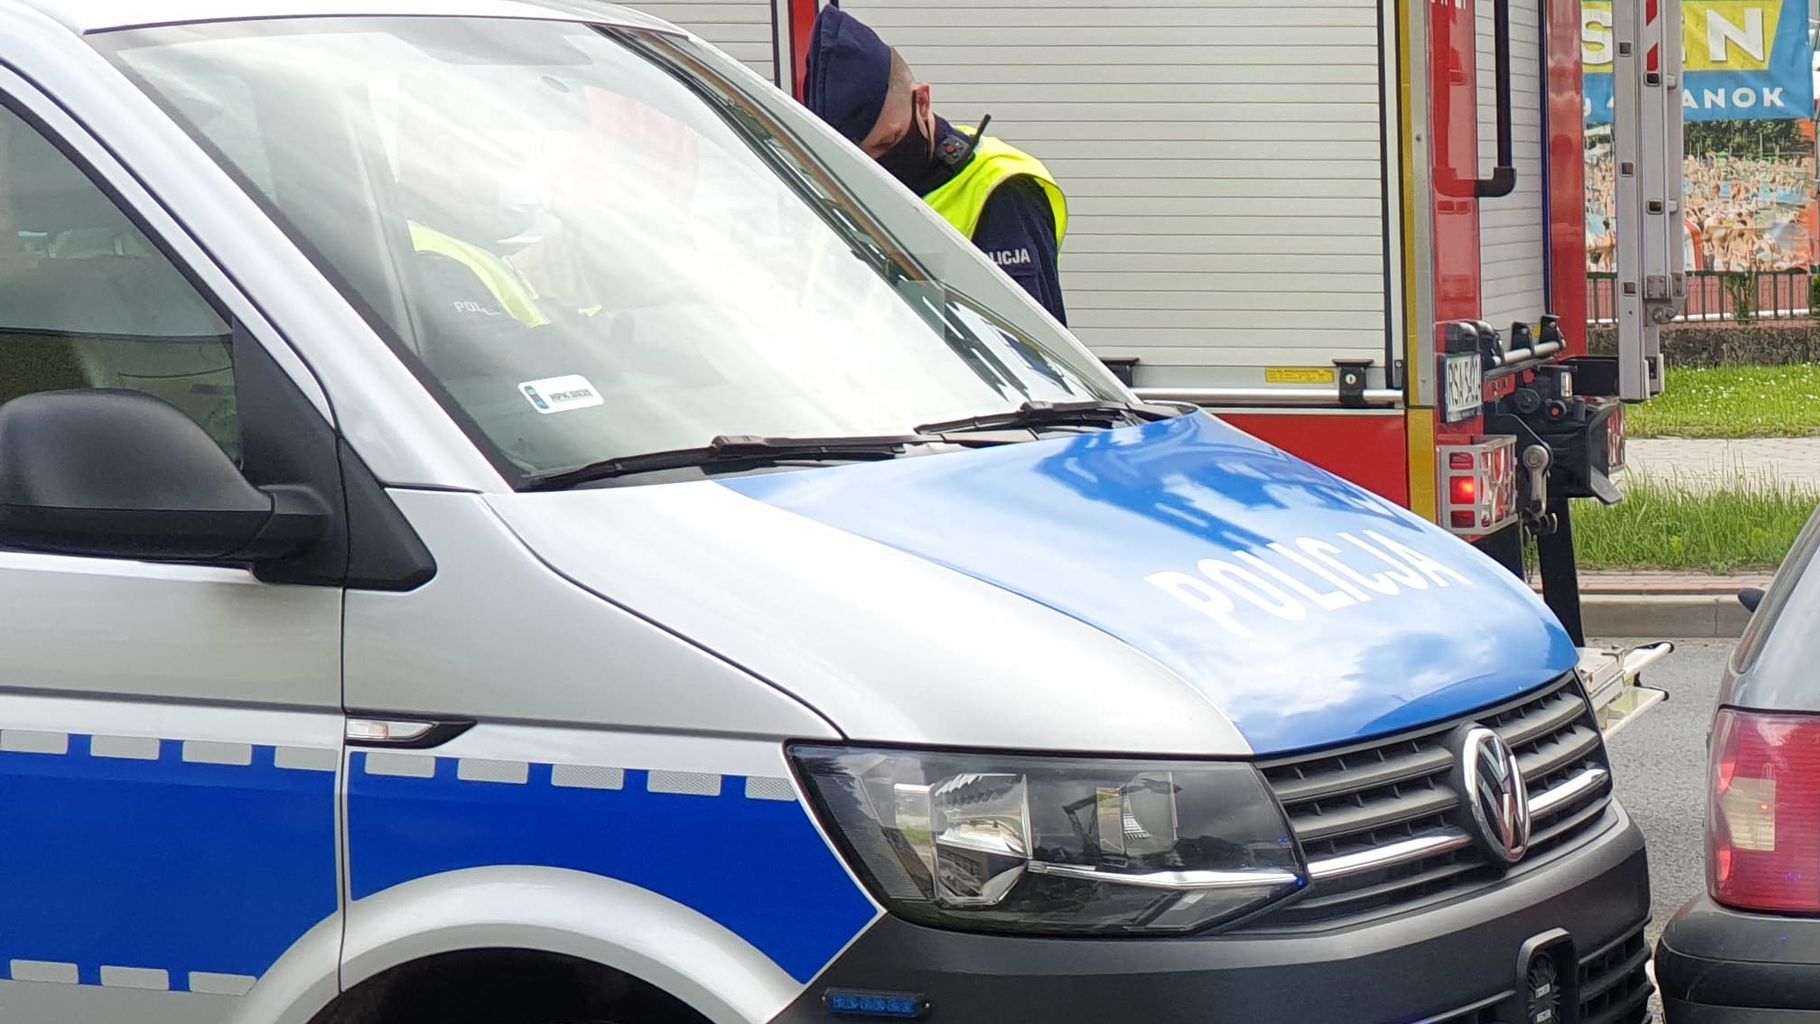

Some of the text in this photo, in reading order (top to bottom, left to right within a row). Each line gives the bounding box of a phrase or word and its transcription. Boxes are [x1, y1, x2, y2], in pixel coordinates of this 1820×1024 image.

[1683, 87, 1785, 109] ANOK
[989, 247, 1031, 265] LICJA
[1144, 530, 1473, 638] POLICJA
